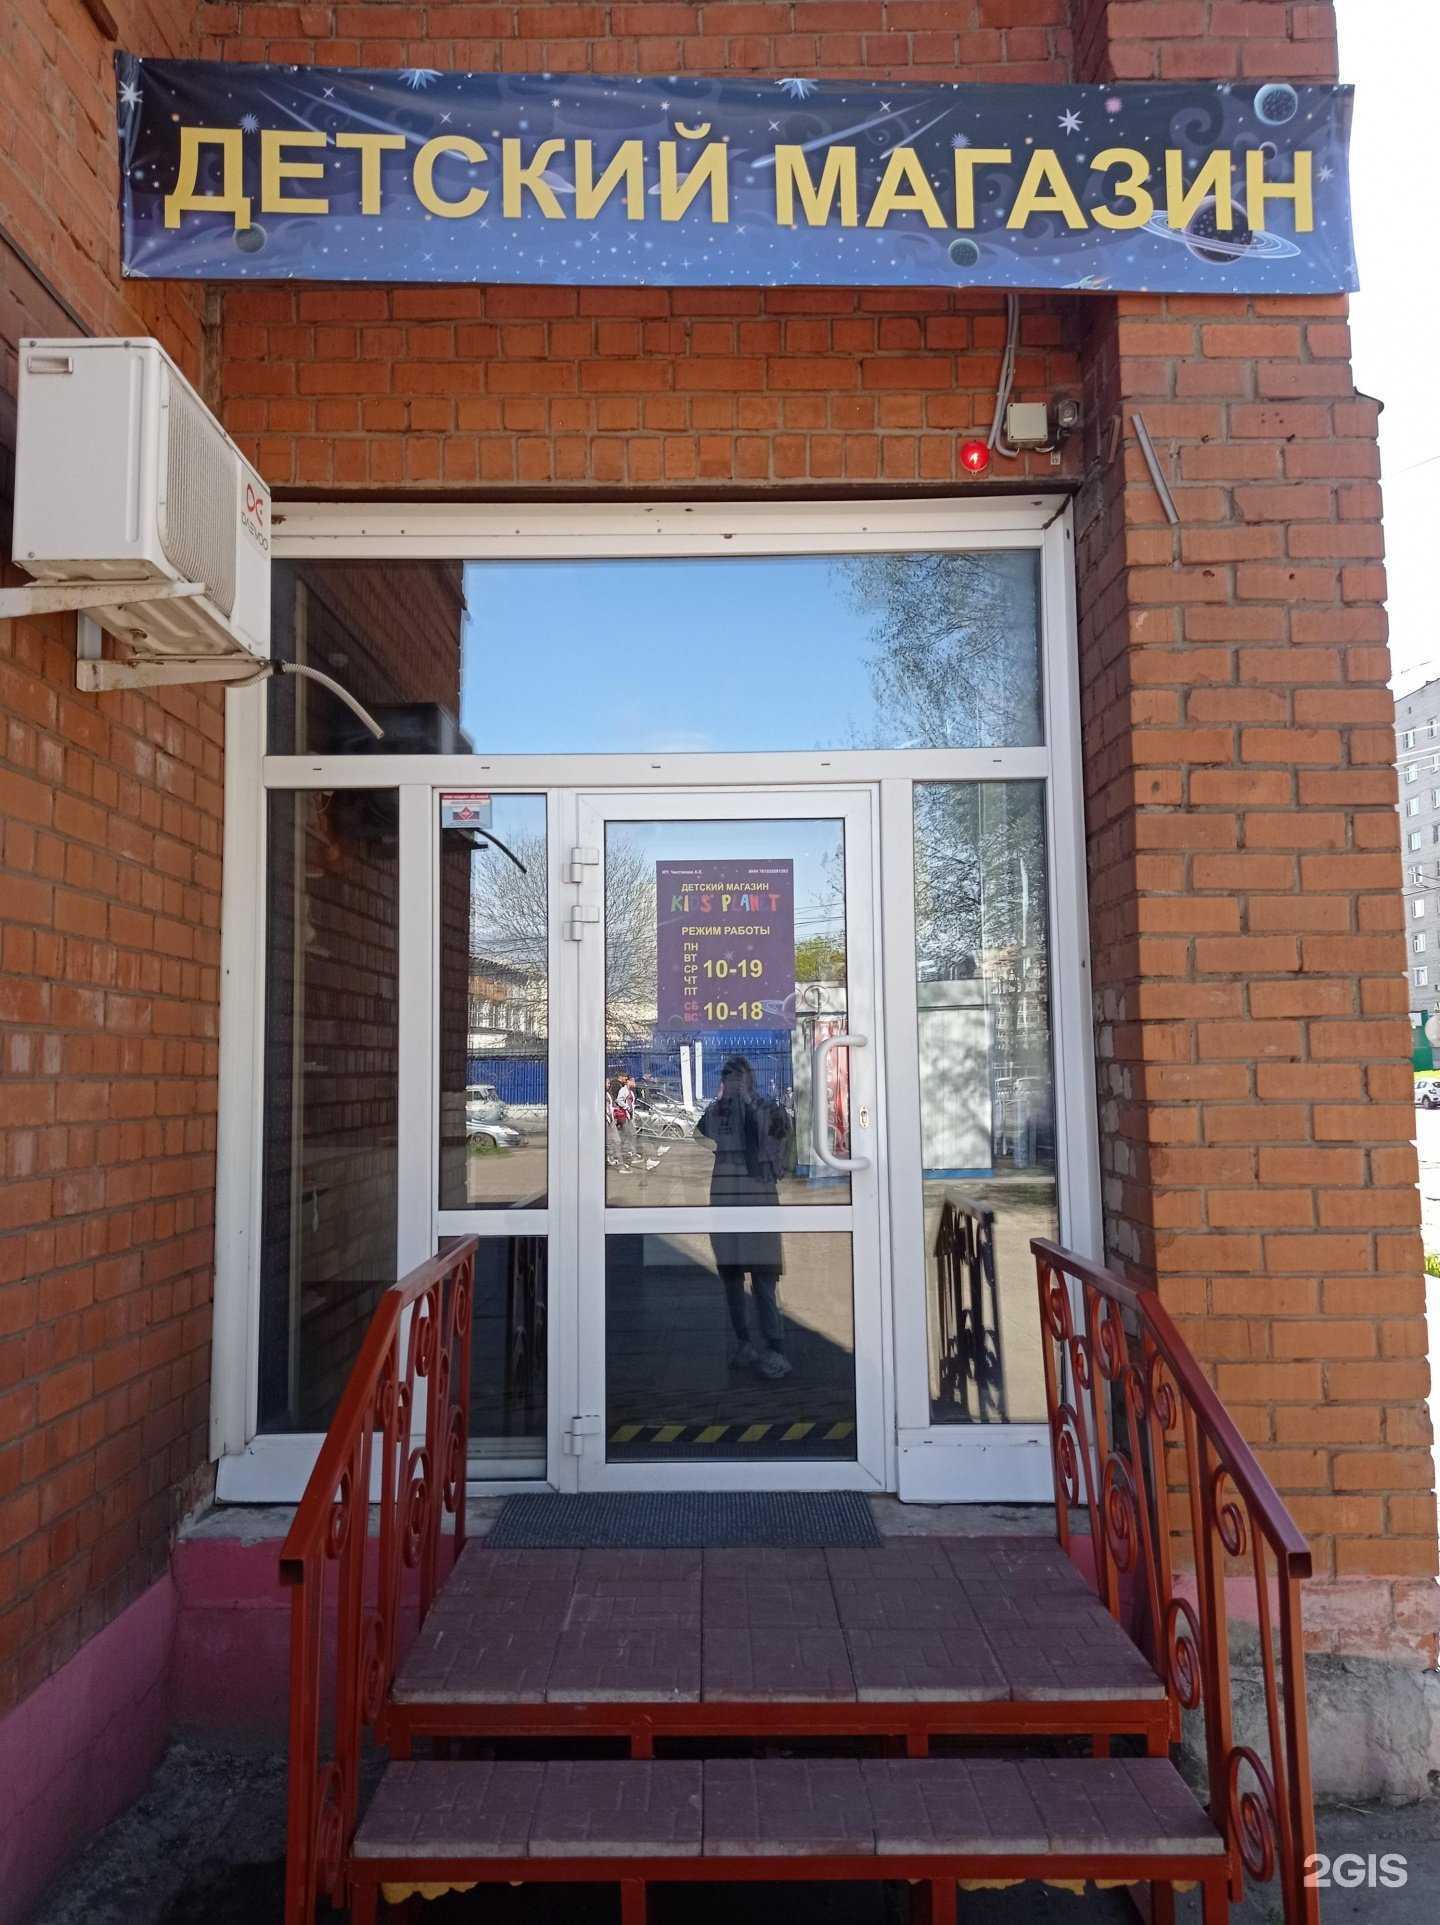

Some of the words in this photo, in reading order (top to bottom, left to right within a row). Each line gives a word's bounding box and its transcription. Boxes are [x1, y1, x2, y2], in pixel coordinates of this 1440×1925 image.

[164, 121, 730, 229] ДЕТСКИЙ
[773, 144, 1314, 233] МАГАЗИН
[681, 882, 724, 892] ДЕТСКИЙ
[726, 882, 769, 891] МАГАЗИН
[681, 926, 721, 936] РЕЖИМ
[724, 926, 770, 935] РАБОТЫ
[683, 942, 698, 951] ПН
[683, 953, 697, 962] ВТ
[683, 964, 698, 973] СР
[703, 959, 763, 978] 10-19
[683, 976, 697, 984] ЧТ
[684, 987, 698, 996] ПТ
[683, 1001, 699, 1010] СБ
[703, 1002, 763, 1020] 10-18
[683, 1012, 698, 1021] ВС
